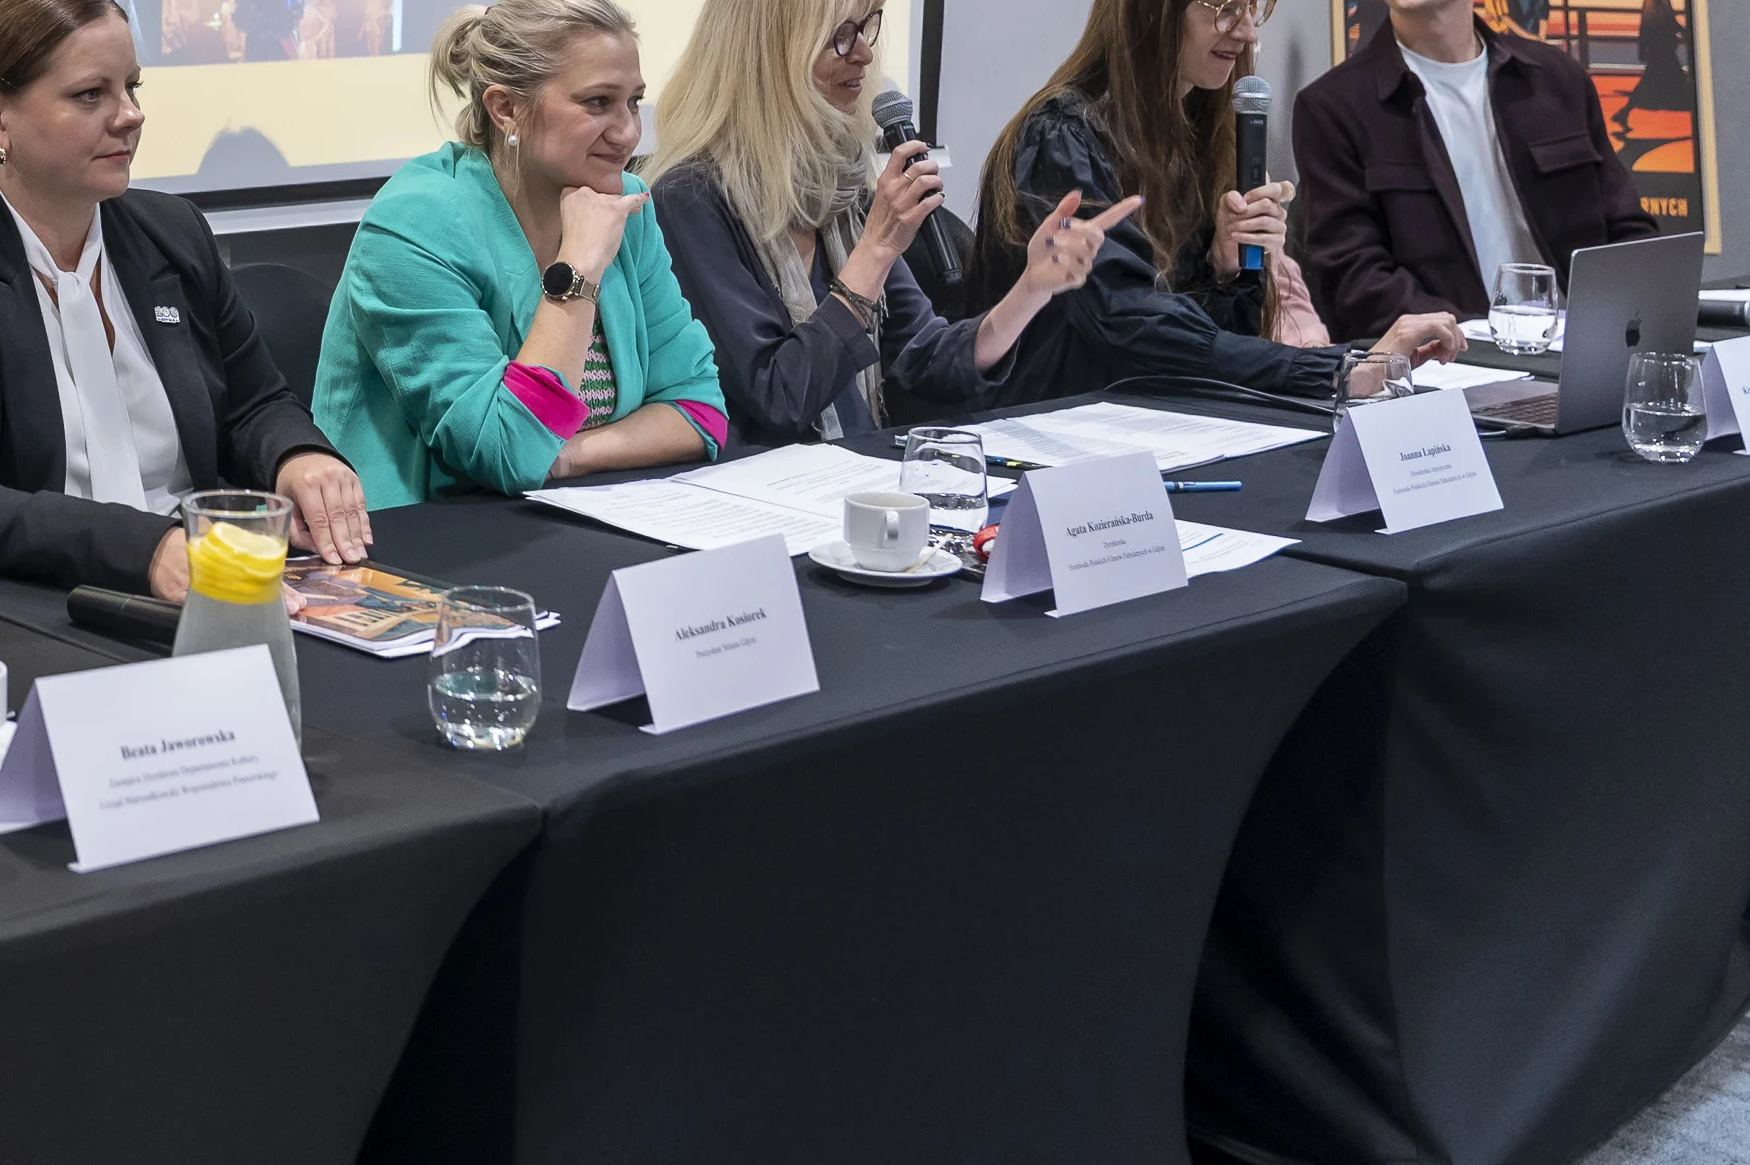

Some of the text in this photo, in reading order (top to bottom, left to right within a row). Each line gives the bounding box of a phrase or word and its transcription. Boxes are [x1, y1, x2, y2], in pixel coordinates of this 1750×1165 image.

[1400, 451, 1422, 461] Joanna
[1066, 510, 1154, 538] Agata Kozierańska-Burda
[675, 619, 726, 642] Aleksandra
[120, 729, 236, 759] Beata Jaworowska
